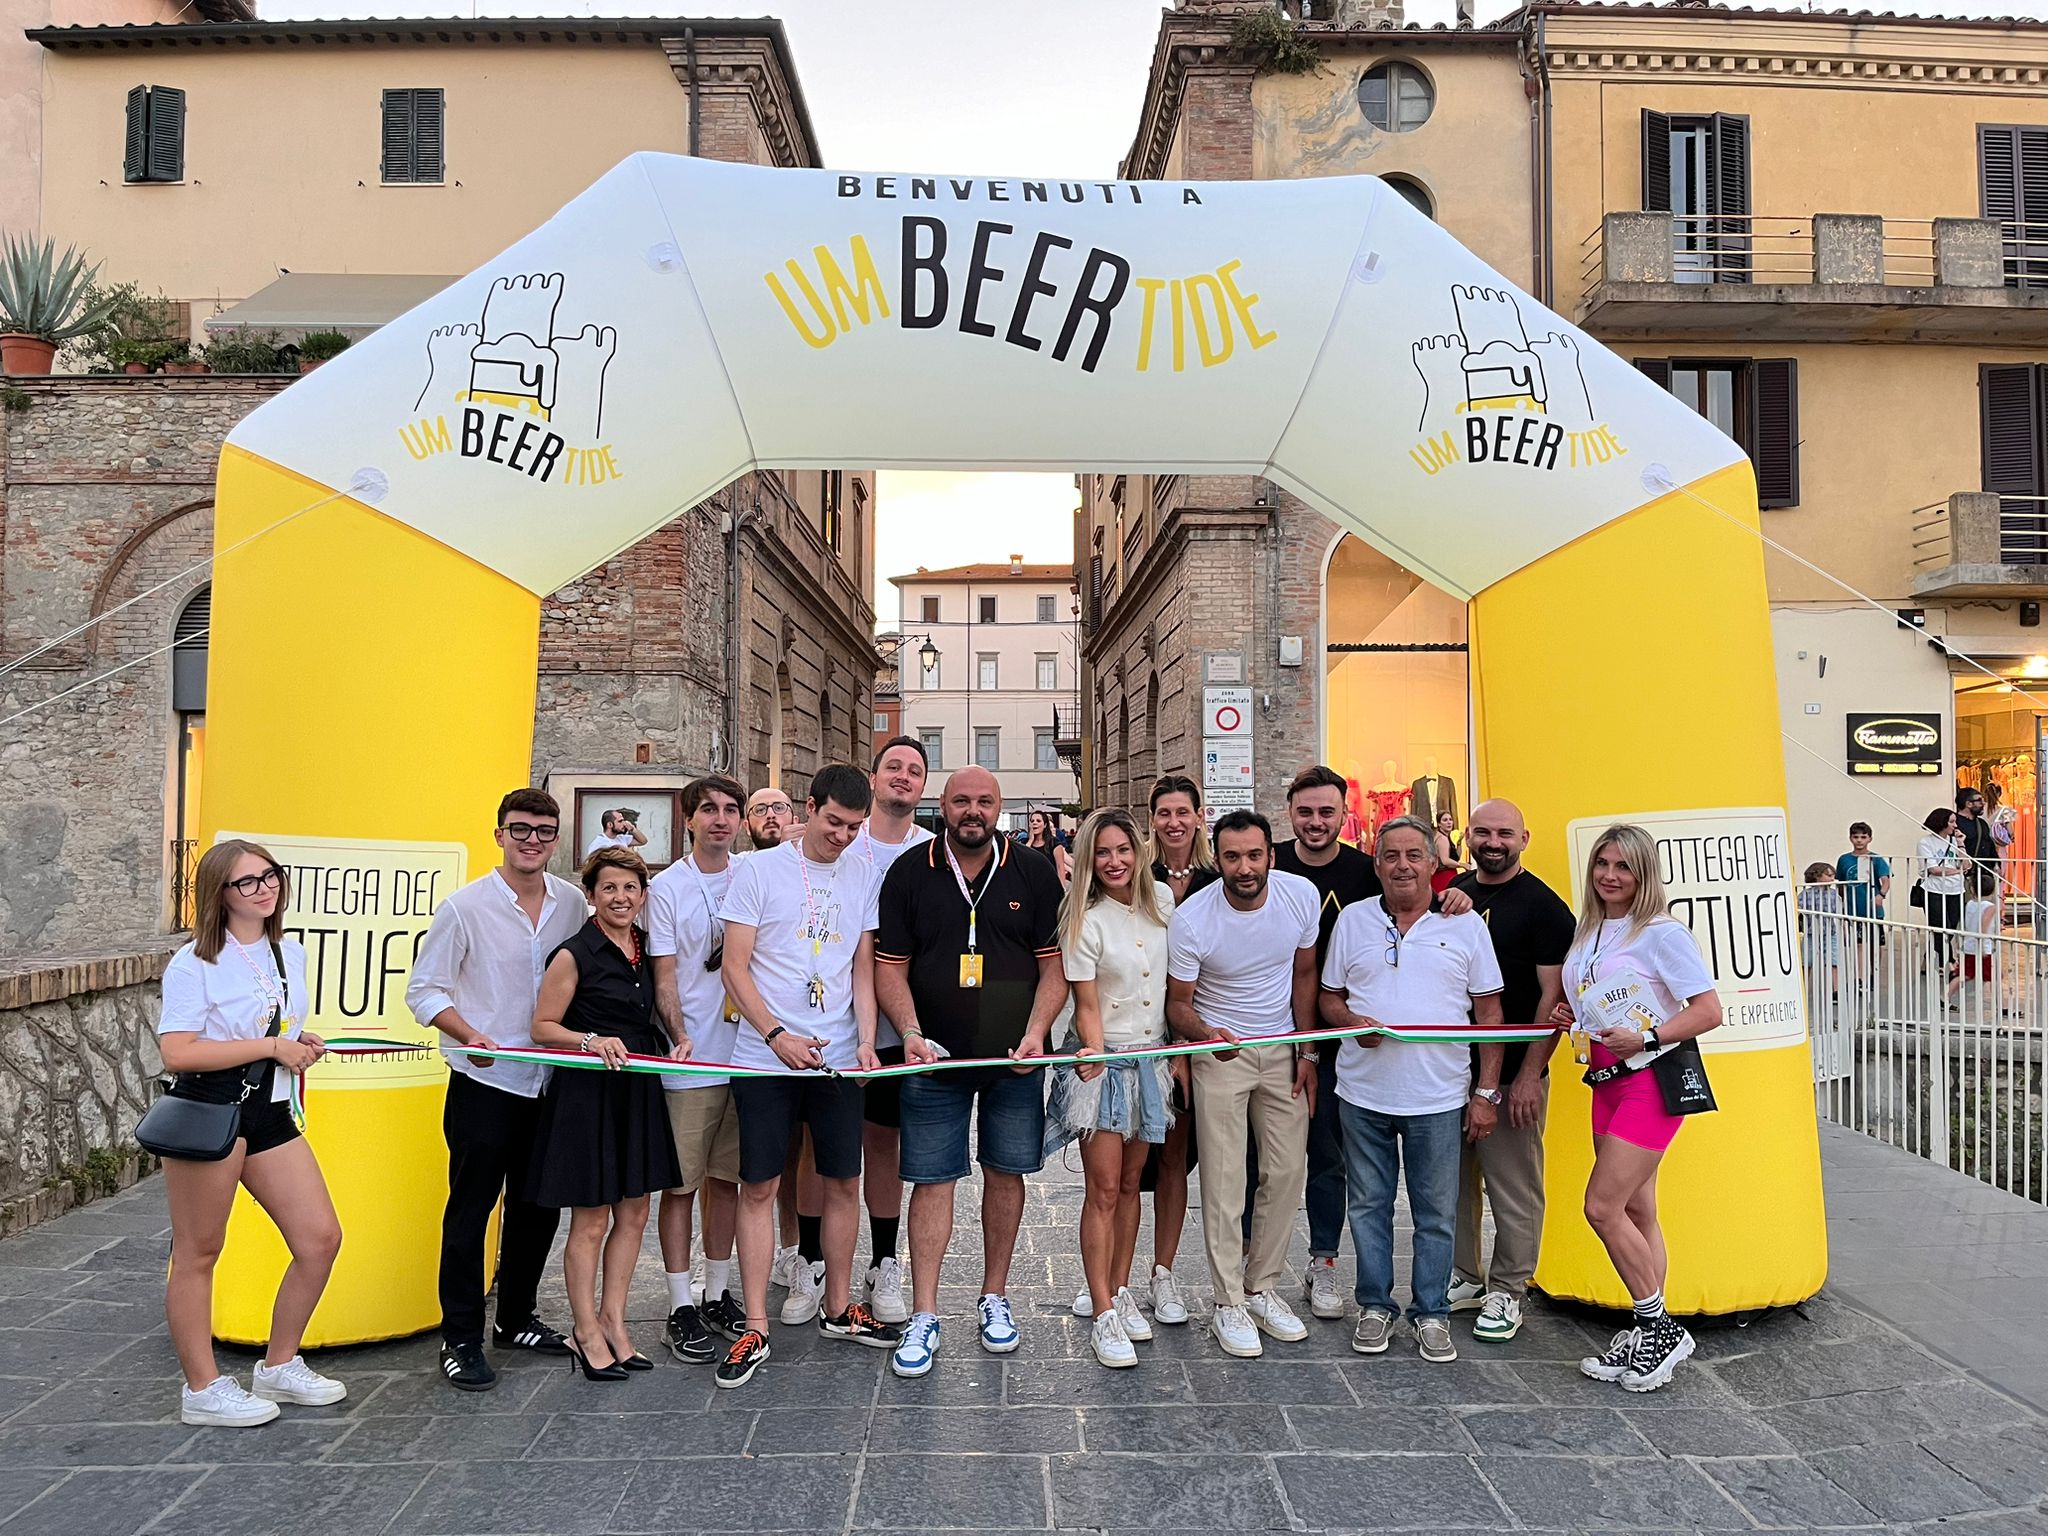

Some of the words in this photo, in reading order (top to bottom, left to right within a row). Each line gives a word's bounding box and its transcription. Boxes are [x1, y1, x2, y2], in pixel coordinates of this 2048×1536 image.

[838, 175, 1142, 204] BENVENUTI
[1183, 188, 1202, 205] A
[1754, 834, 1784, 879] DEL
[283, 927, 429, 1017] TUF
[1741, 1000, 1797, 1025] EXPERIENCE
